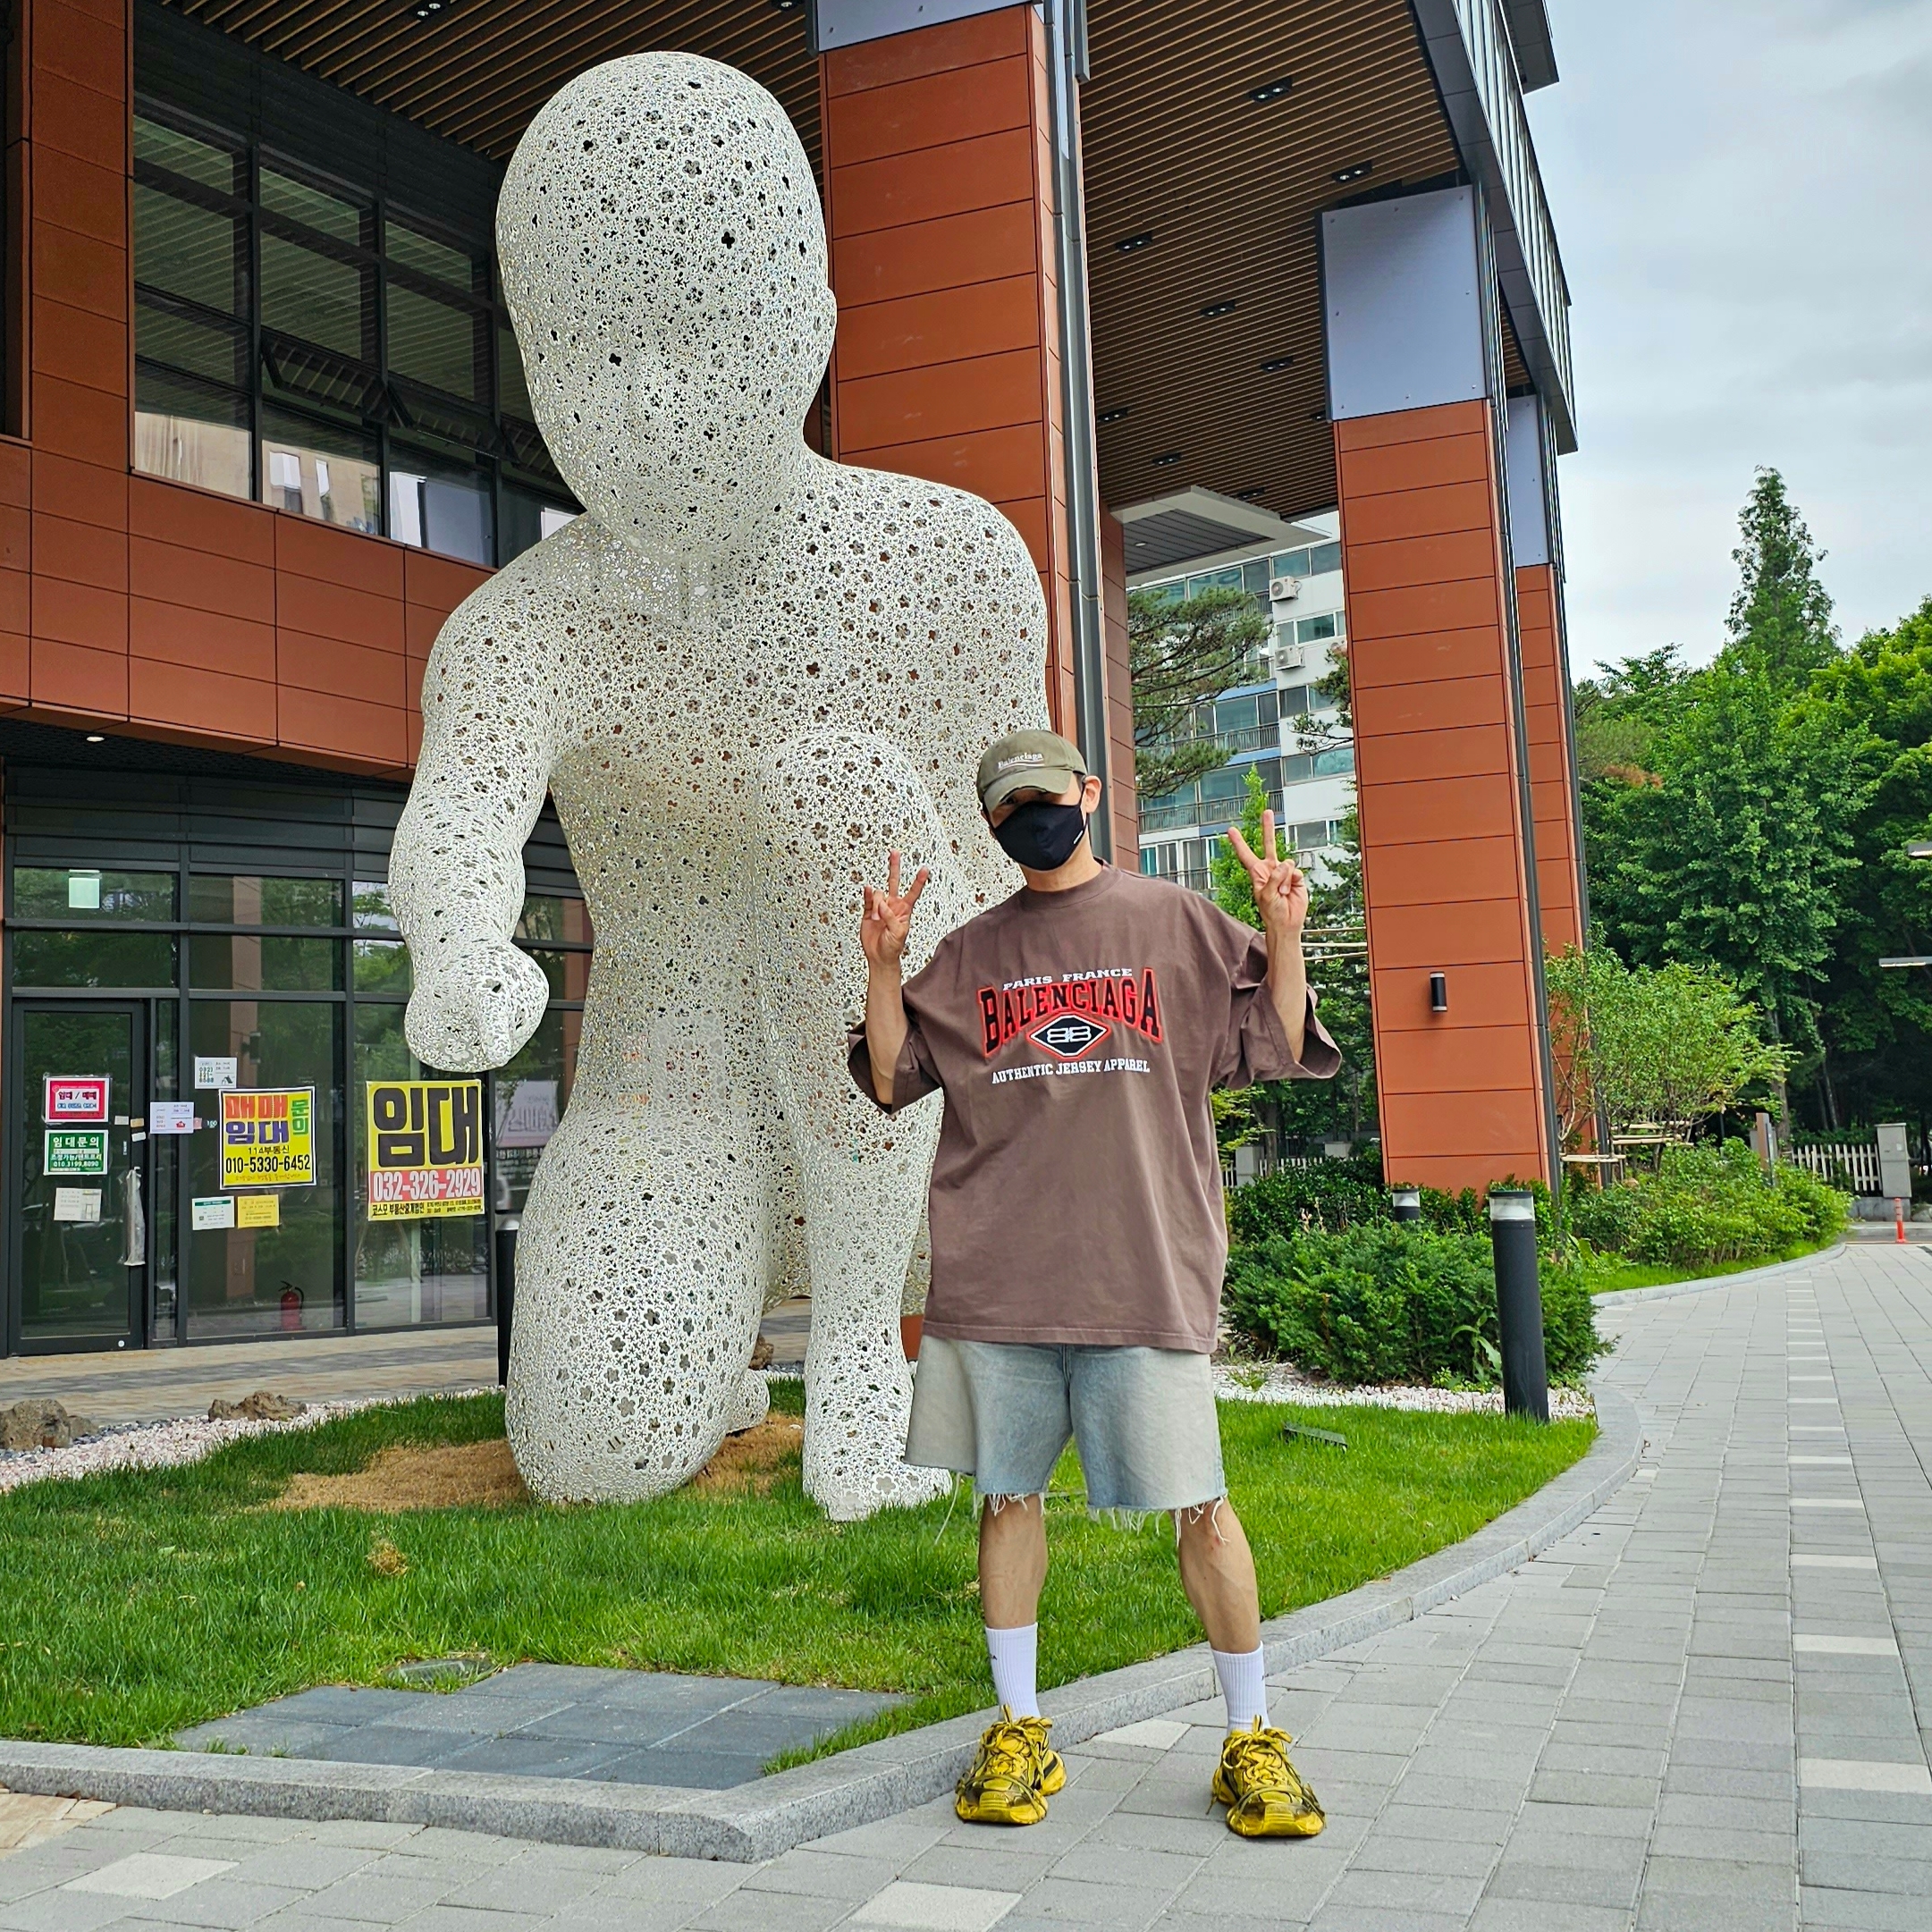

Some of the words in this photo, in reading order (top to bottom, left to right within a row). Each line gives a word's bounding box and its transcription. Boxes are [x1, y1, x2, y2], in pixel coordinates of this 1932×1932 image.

[1003, 975, 1053, 991] PARIS
[1062, 968, 1133, 983] FRANCE
[977, 966, 1162, 1058] BALENCIAGA
[991, 1062, 1053, 1084] AUTHENTIC
[1055, 1059, 1102, 1076] JERSEY
[1103, 1058, 1151, 1073] APPAREL
[225, 1095, 288, 1119] 매매
[291, 1099, 309, 1135] 문의
[226, 1121, 290, 1144] 임대
[374, 1086, 479, 1167] 임대
[53, 1136, 99, 1148] 임대문의
[225, 1154, 311, 1174] 010-5330-6452
[373, 1168, 481, 1202] 032-326-2929
